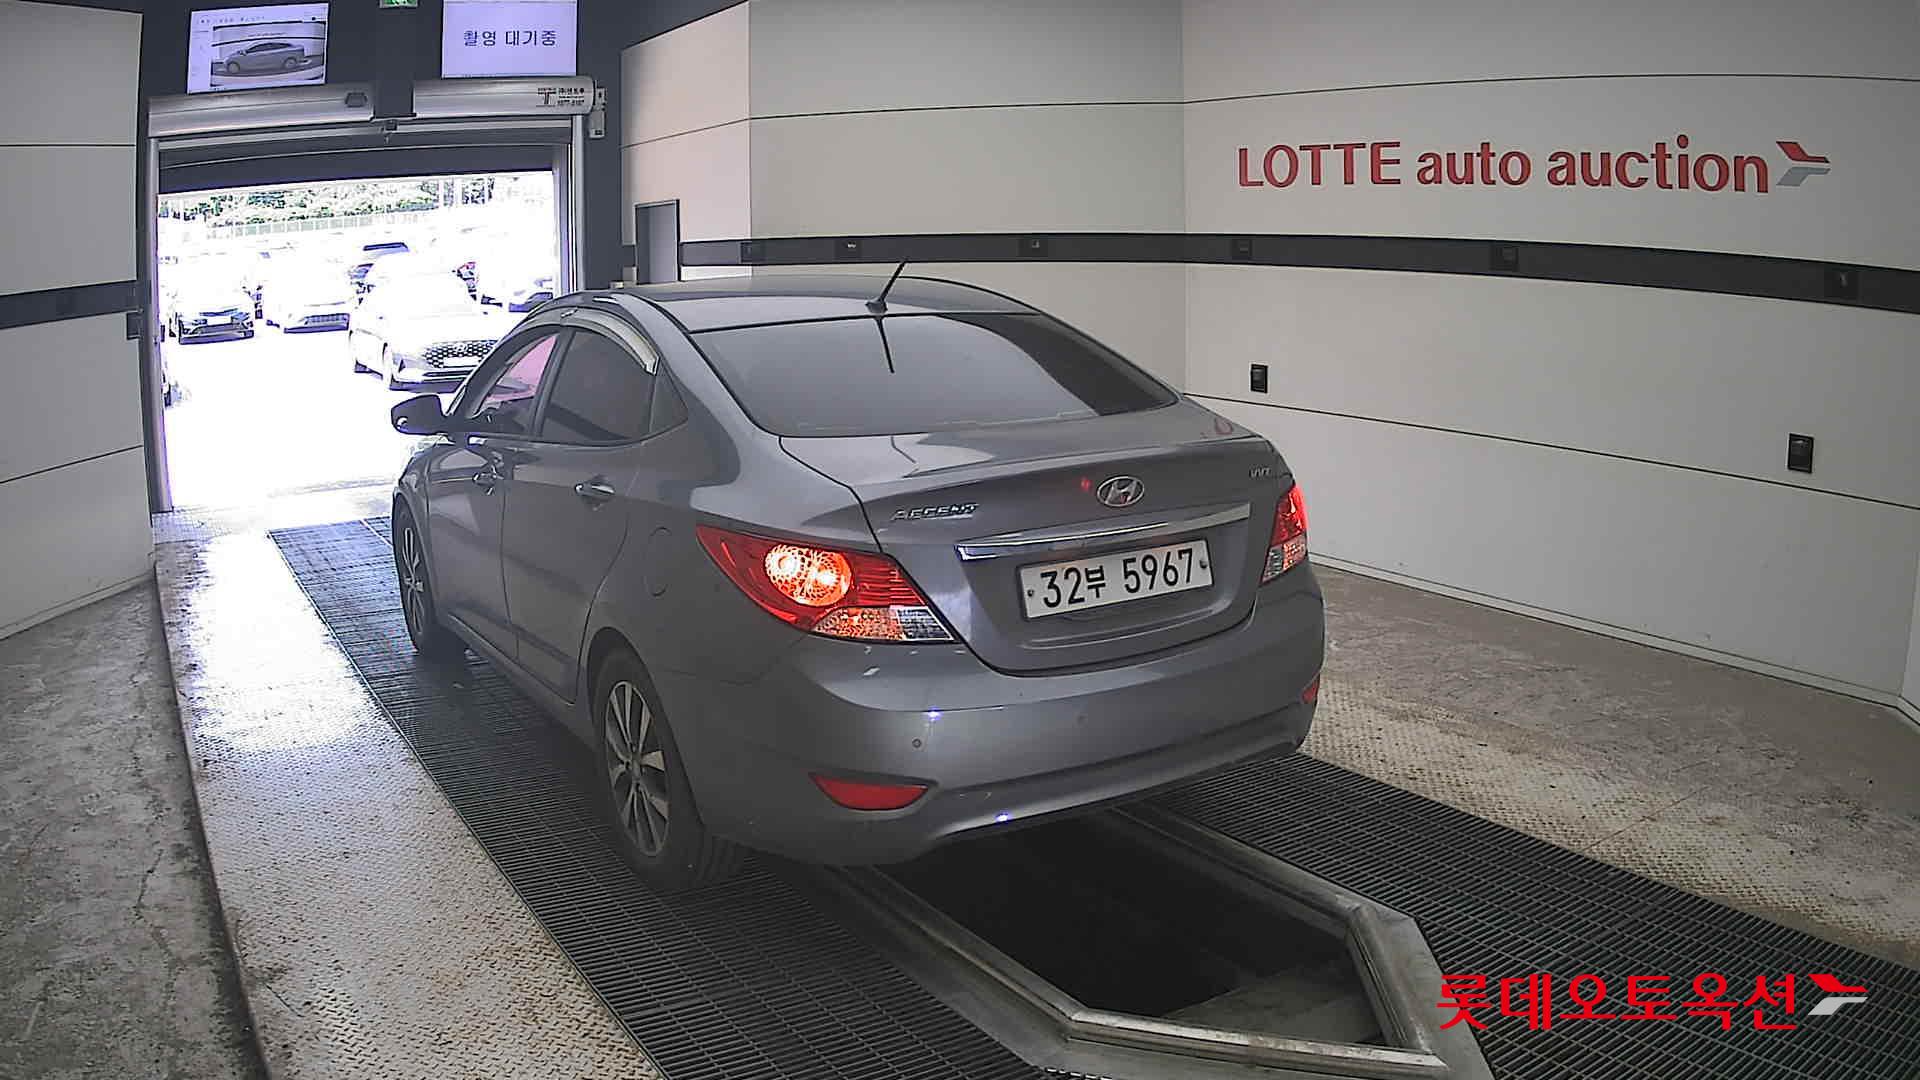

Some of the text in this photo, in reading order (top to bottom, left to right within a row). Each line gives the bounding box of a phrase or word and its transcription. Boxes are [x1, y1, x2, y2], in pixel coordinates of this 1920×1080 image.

[464, 30, 557, 47] 촬영 대기중
[1238, 133, 1769, 194] LOTTE auto auction
[1040, 548, 1197, 608] 32부 5967
